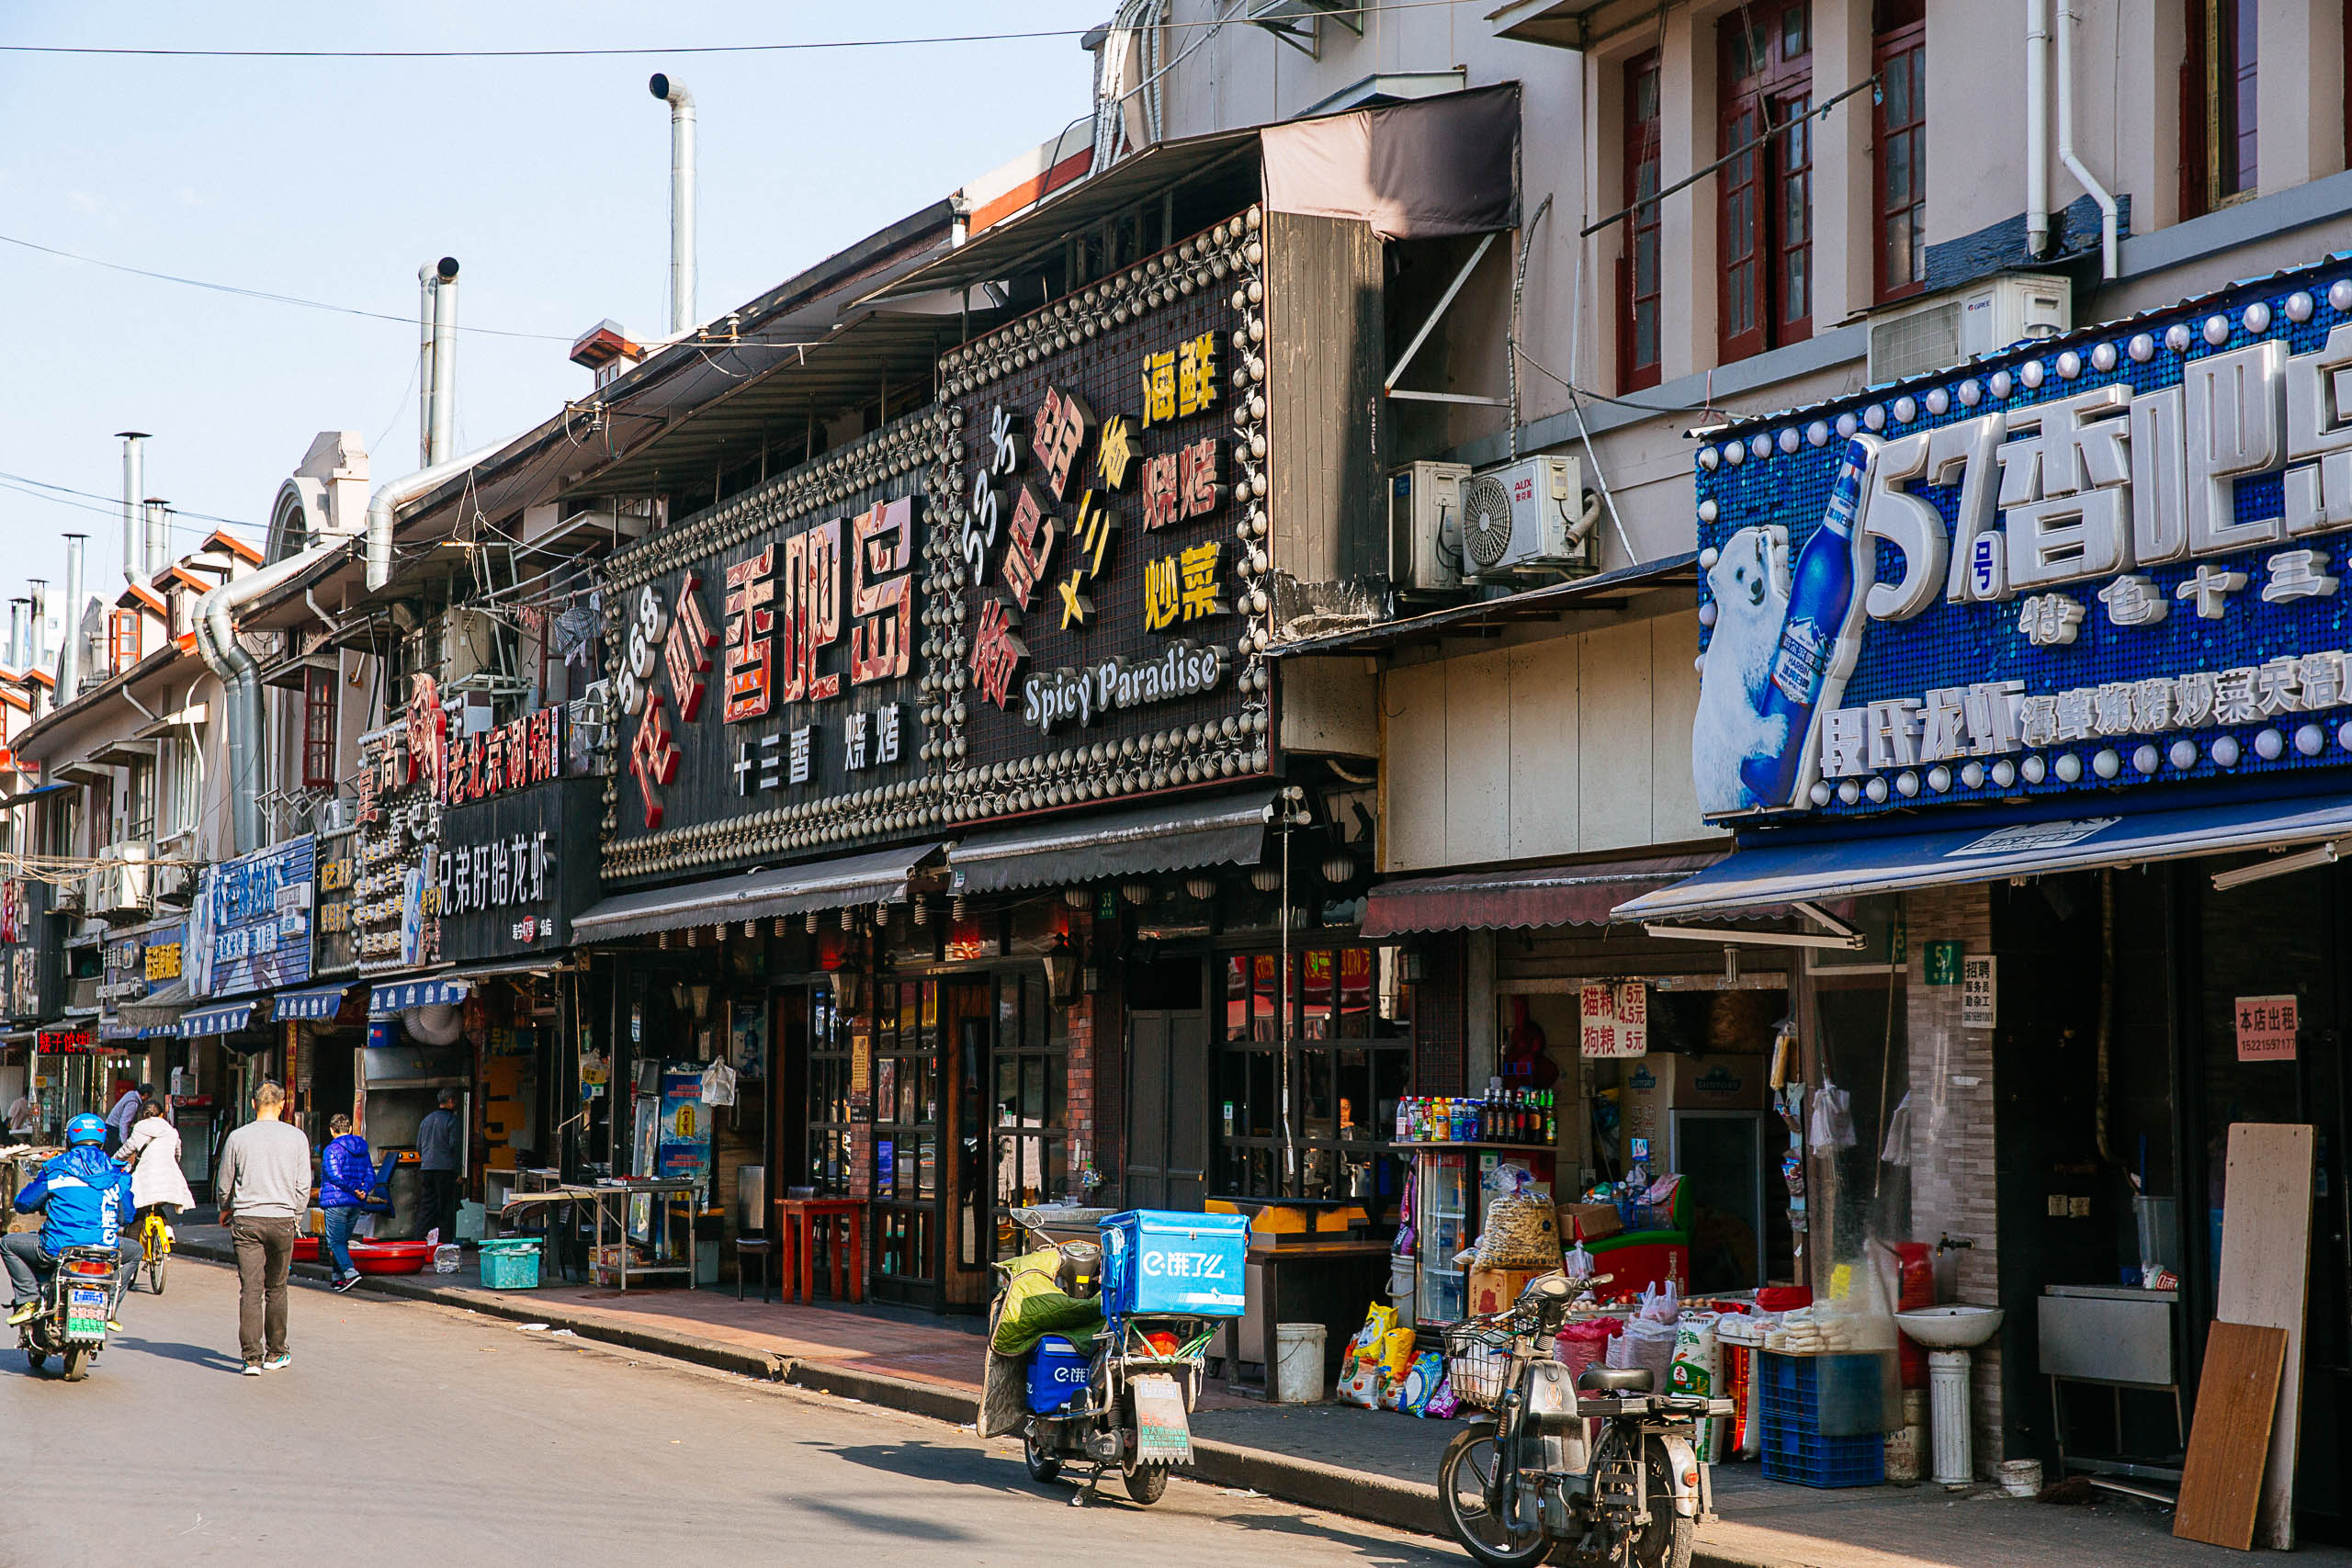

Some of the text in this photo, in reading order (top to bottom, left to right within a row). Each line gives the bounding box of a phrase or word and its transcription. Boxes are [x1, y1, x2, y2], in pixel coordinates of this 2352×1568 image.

[1973, 299, 1991, 310] GREE
[1142, 330, 1217, 429] 海鲜
[1142, 436, 1218, 534] 烧烤
[1514, 478, 1532, 491] AUX
[969, 385, 1089, 713] 香吧岛
[1145, 540, 1222, 633] 炒菜
[2019, 549, 2352, 646] 特色十三
[723, 495, 912, 725] 香吧岛
[616, 584, 665, 716] 568
[1788, 654, 1810, 677] HARBIN
[1024, 644, 1217, 735] Spicy Paradise
[448, 708, 550, 805] 老北京涮锅
[734, 701, 900, 796] 十三香 烧烤
[390, 797, 439, 848] 香吧岛
[438, 830, 548, 918] 兄弟盱眙龙虾
[1934, 945, 1953, 968] 57
[1966, 960, 1990, 979] 招聘
[1583, 984, 1645, 1019] 猫粮 5元
[1965, 980, 1990, 993] 服务员
[1619, 1006, 1645, 1025] 4.5元
[2239, 1006, 2295, 1034] 本店出租
[1583, 1025, 1645, 1056] 狗粮 5元
[1697, 1080, 1738, 1089] SUNTORY
[1168, 1252, 1225, 1279] 饿了么
